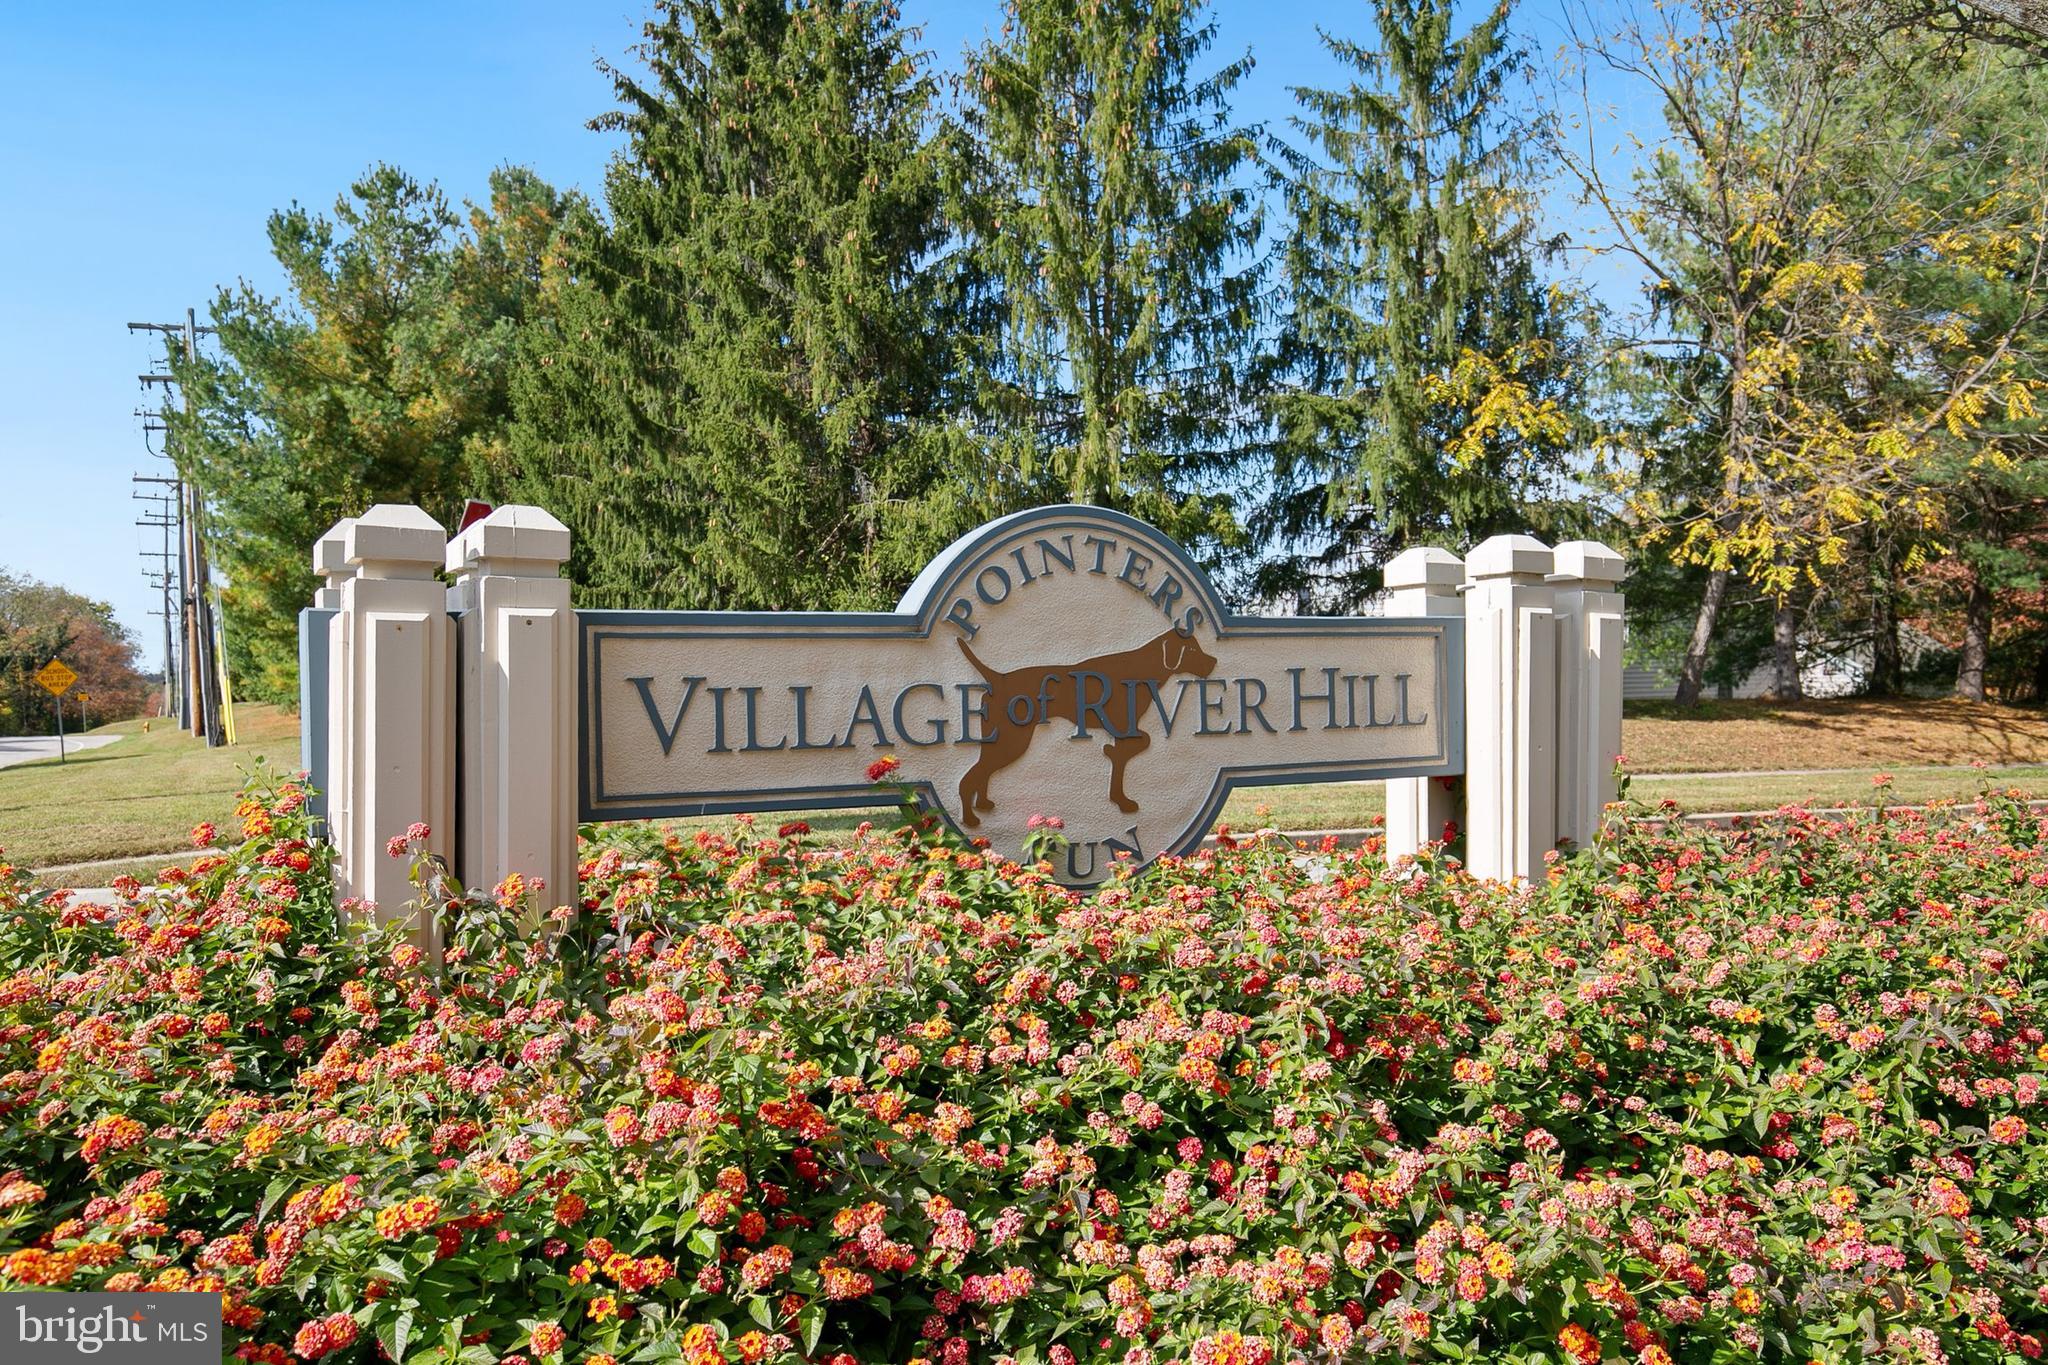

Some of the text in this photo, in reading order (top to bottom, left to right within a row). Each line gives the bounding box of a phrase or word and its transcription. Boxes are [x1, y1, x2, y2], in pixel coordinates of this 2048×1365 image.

[942, 533, 1204, 641] POINTERS
[626, 667, 1429, 757] VILLAGE of RIVER HILL
